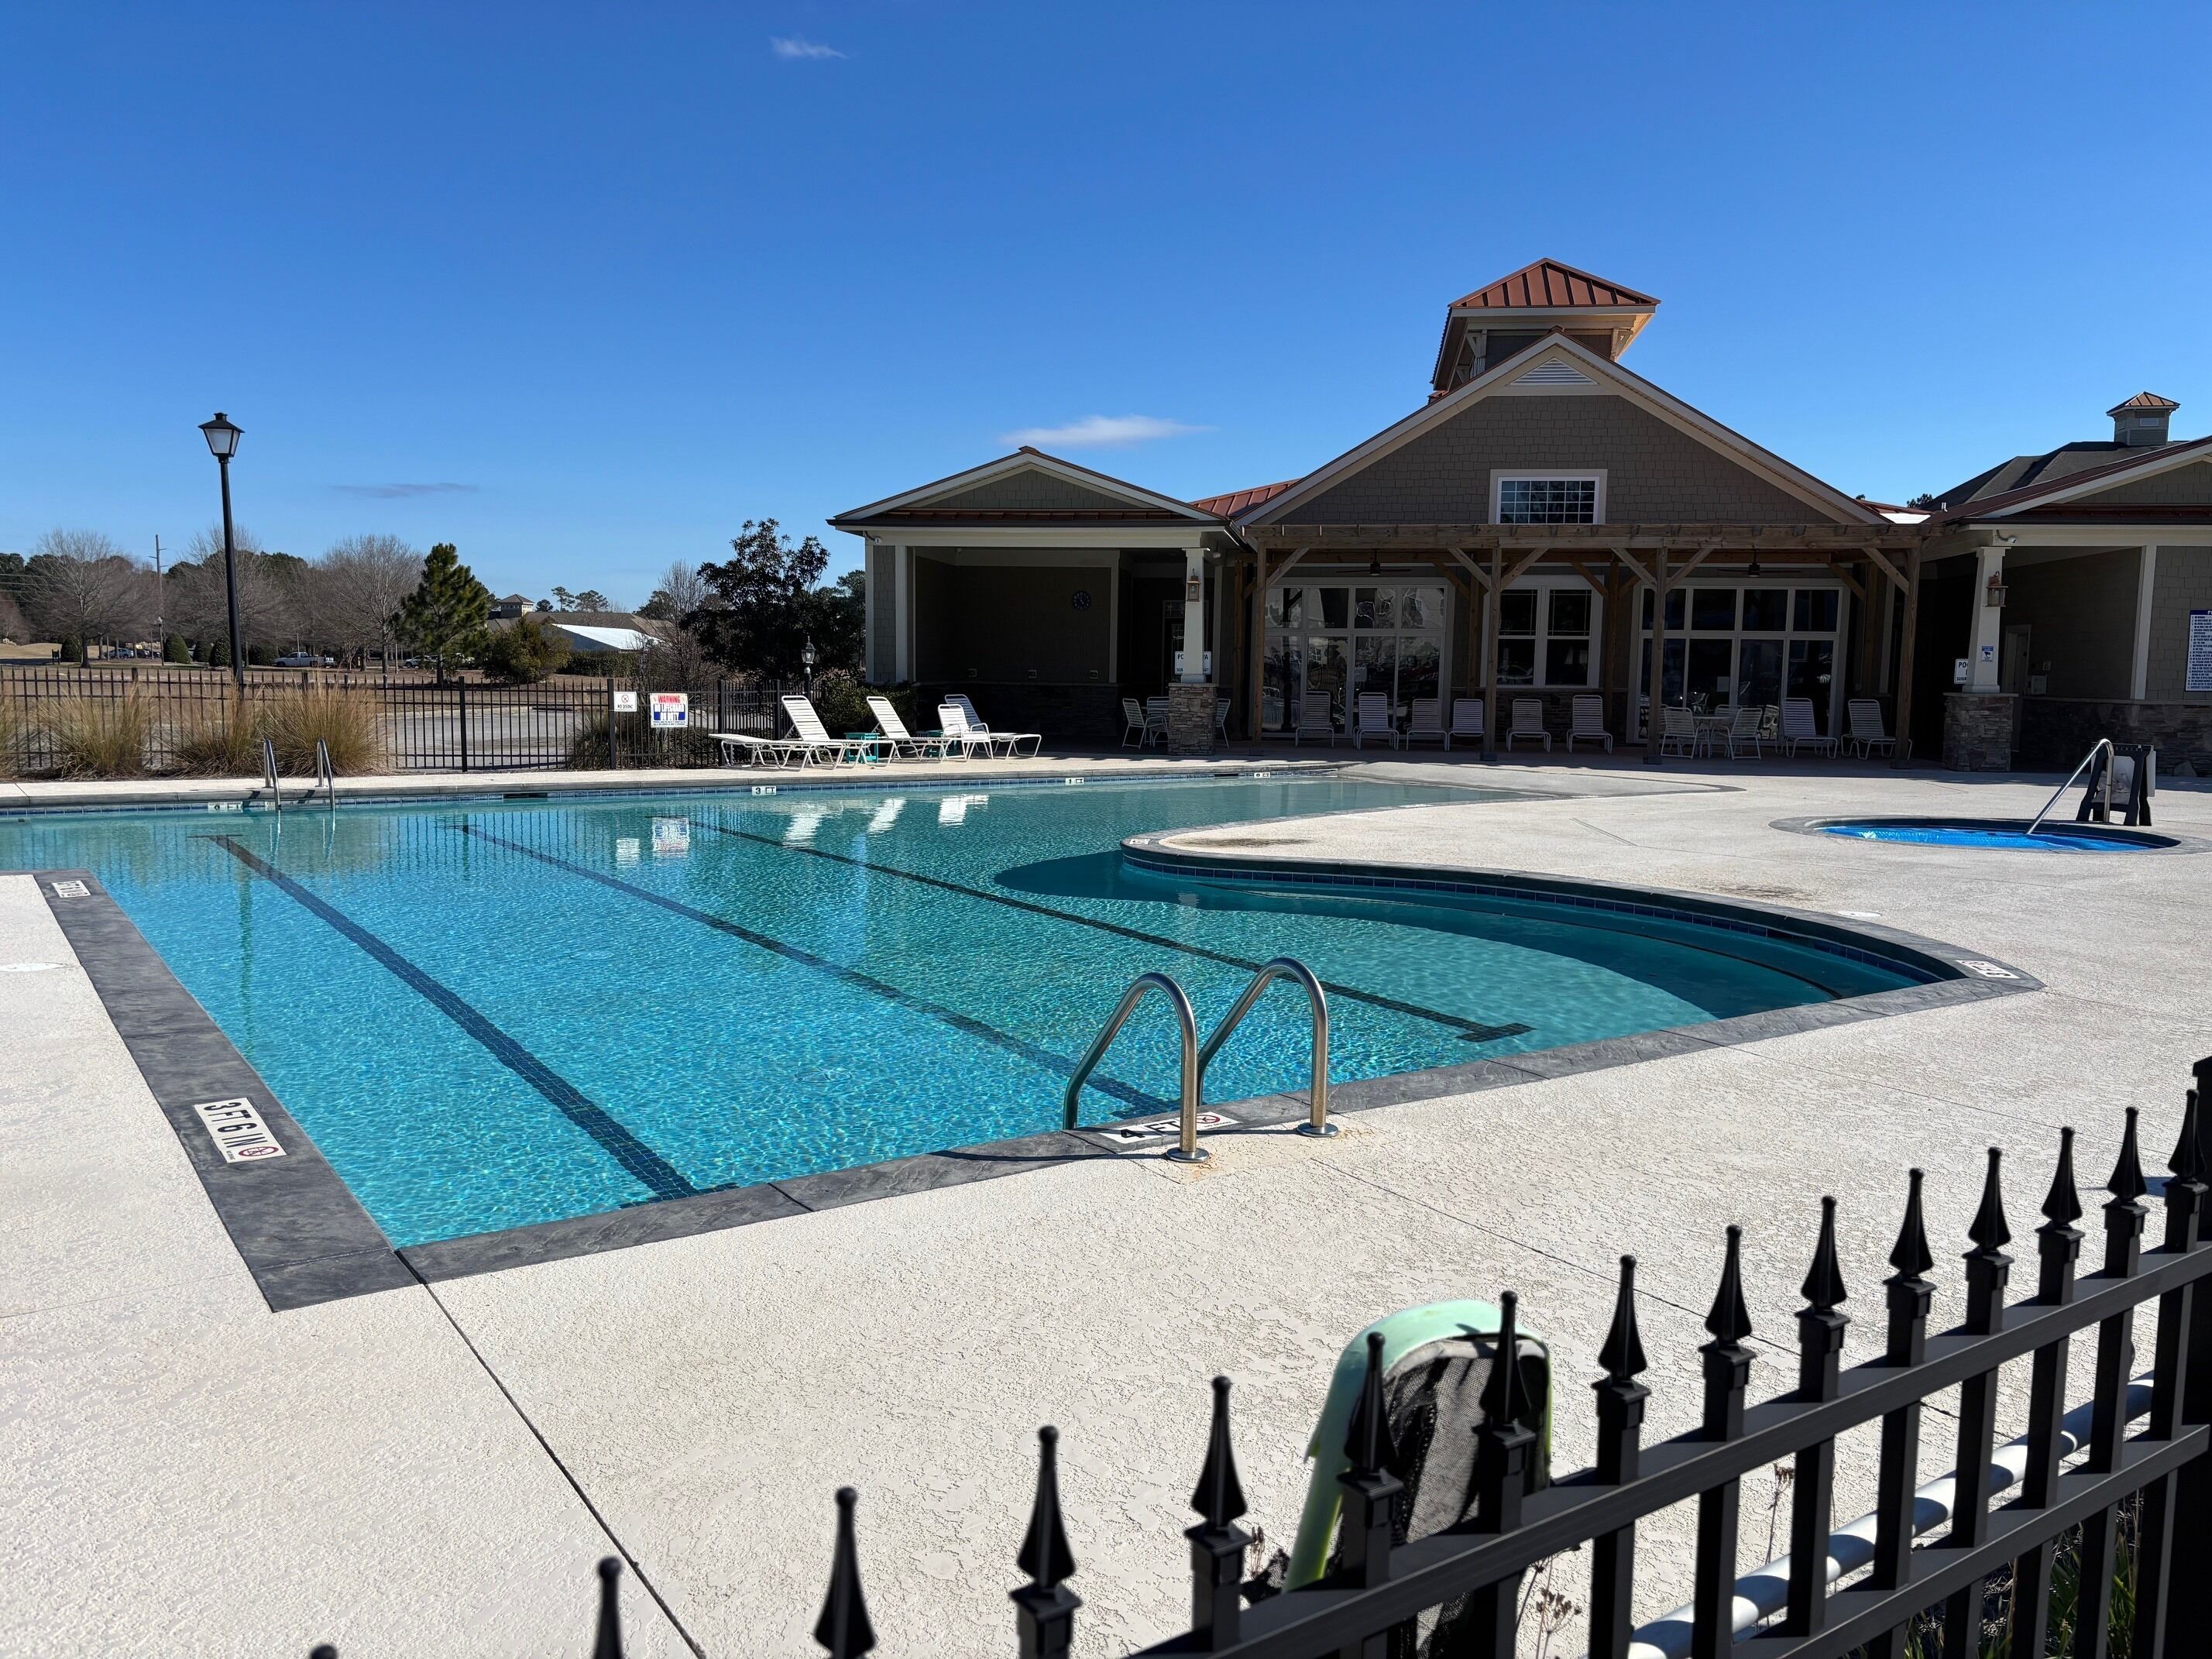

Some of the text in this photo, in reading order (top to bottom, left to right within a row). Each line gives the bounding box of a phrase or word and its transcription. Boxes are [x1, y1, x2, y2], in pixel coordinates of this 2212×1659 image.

[204, 1102, 242, 1111] 3
[218, 1123, 257, 1132] 6
[1120, 1121, 1180, 1138] 4 FT
